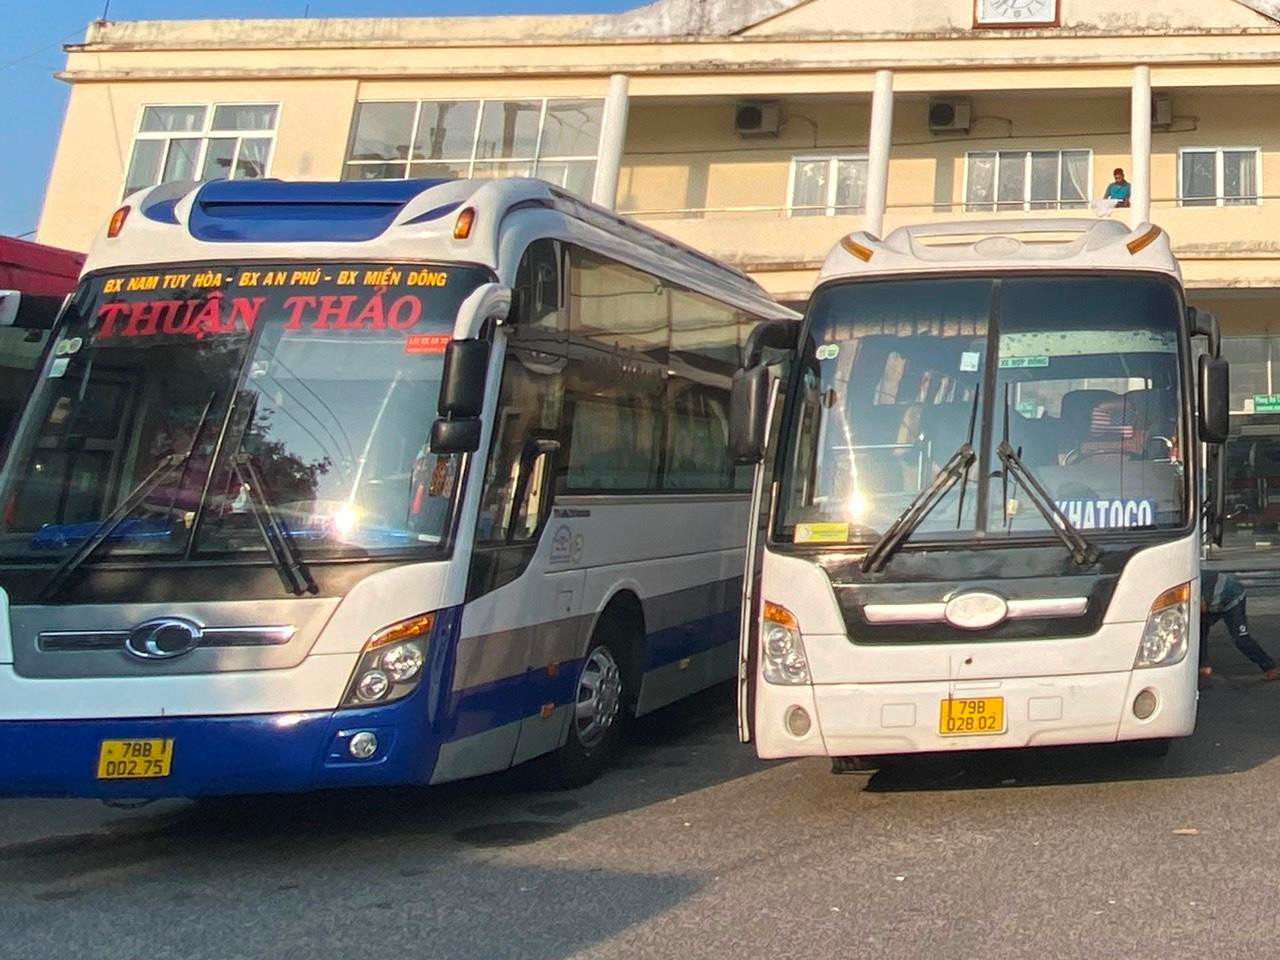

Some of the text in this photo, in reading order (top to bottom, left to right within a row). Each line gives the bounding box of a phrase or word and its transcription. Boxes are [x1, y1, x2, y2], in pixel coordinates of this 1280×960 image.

[103, 278, 126, 294] BX
[127, 275, 160, 291] NAM
[163, 274, 192, 289] TUY
[192, 270, 223, 288] HÒA
[239, 271, 261, 287] BX
[263, 271, 288, 287] AN
[290, 268, 322, 286] PHÚ
[337, 270, 358, 285] BX
[407, 268, 448, 287] ĐÔNG
[96, 285, 423, 340] THUẬN THẢO
[959, 700, 986, 715] 79B
[947, 715, 996, 731] 028.02
[122, 742, 153, 758] 78B
